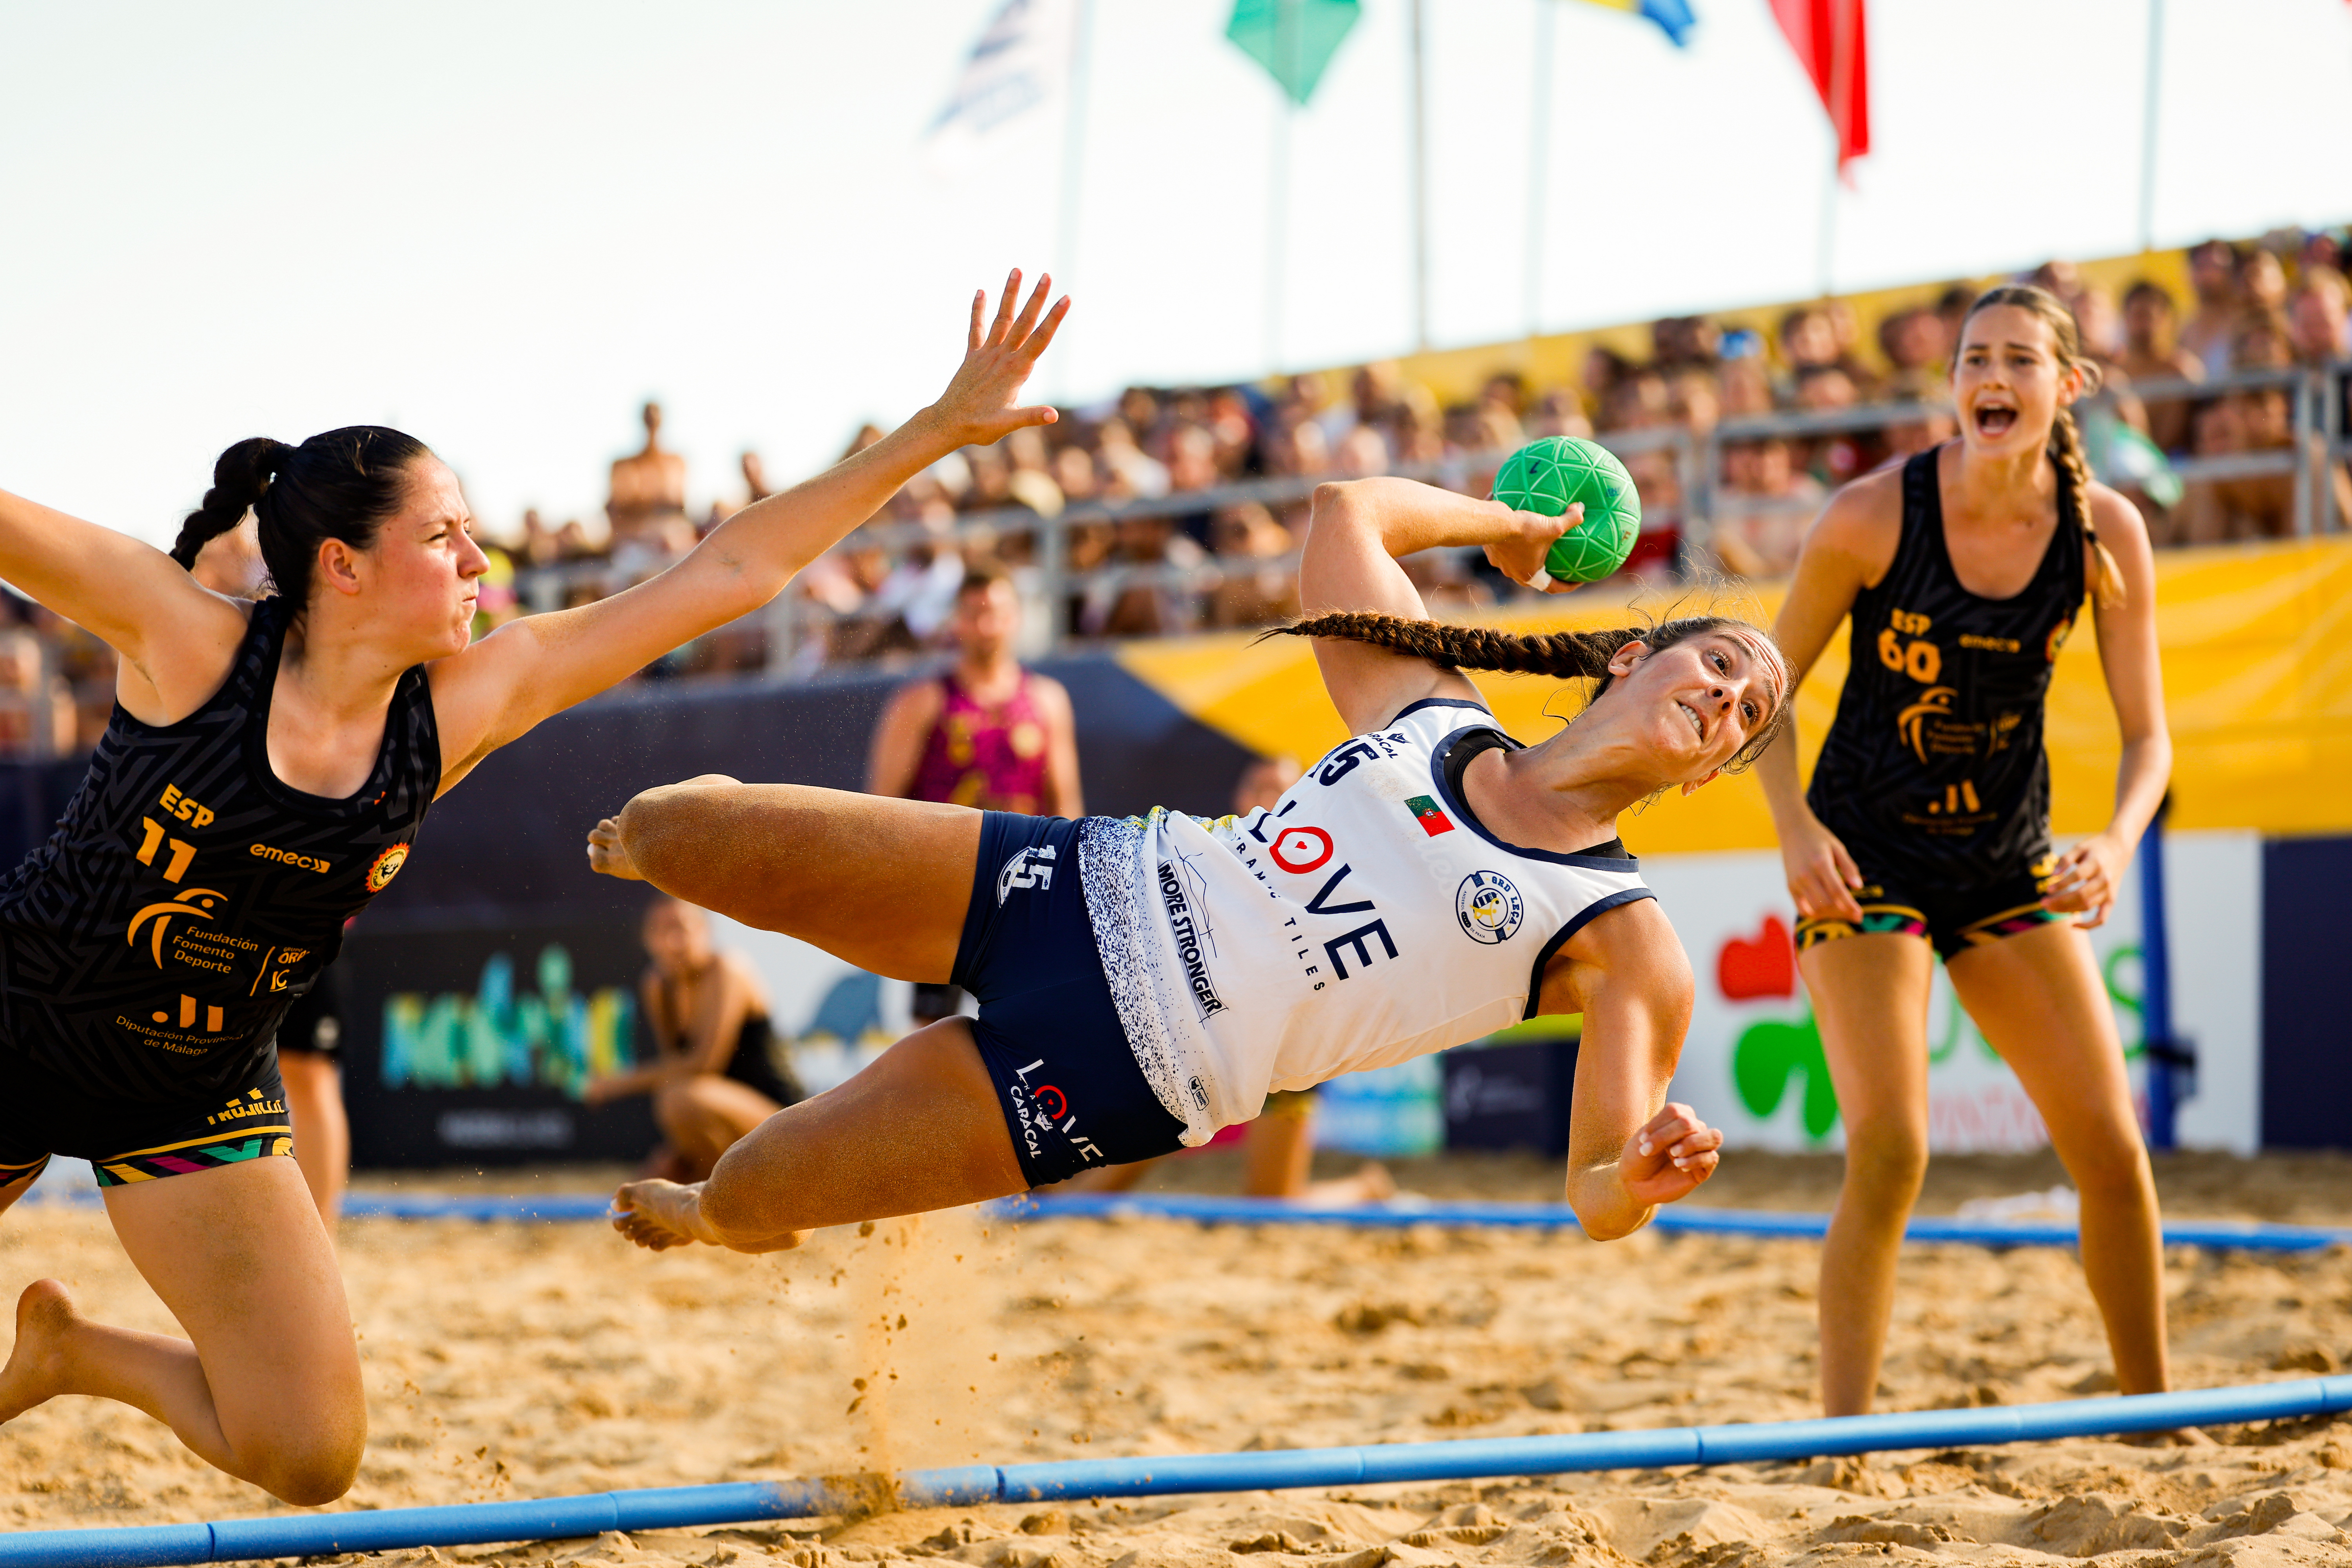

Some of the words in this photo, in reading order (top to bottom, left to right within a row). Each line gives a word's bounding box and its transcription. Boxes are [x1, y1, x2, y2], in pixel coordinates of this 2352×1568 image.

[1891, 608, 1932, 636] ESP
[1878, 628, 1942, 684] 60
[159, 783, 214, 829] ESP
[136, 816, 197, 884] 11
[250, 843, 312, 868] emec
[1012, 845, 1056, 890] 15
[1248, 800, 1399, 980] LOVE
[1492, 876, 1511, 892] GRD
[1509, 896, 1520, 925] LEÇA
[172, 935, 235, 960] Fomento
[187, 926, 258, 952] Fundación
[1158, 863, 1187, 916] MORE
[1173, 916, 1223, 1014] STRONGER
[1284, 917, 1325, 990] TILES
[174, 950, 232, 974] Deporte
[116, 1015, 183, 1041] Diputación
[144, 1039, 161, 1047] de
[163, 1041, 208, 1056] Málaga
[1010, 1085, 1042, 1159] CARACAL
